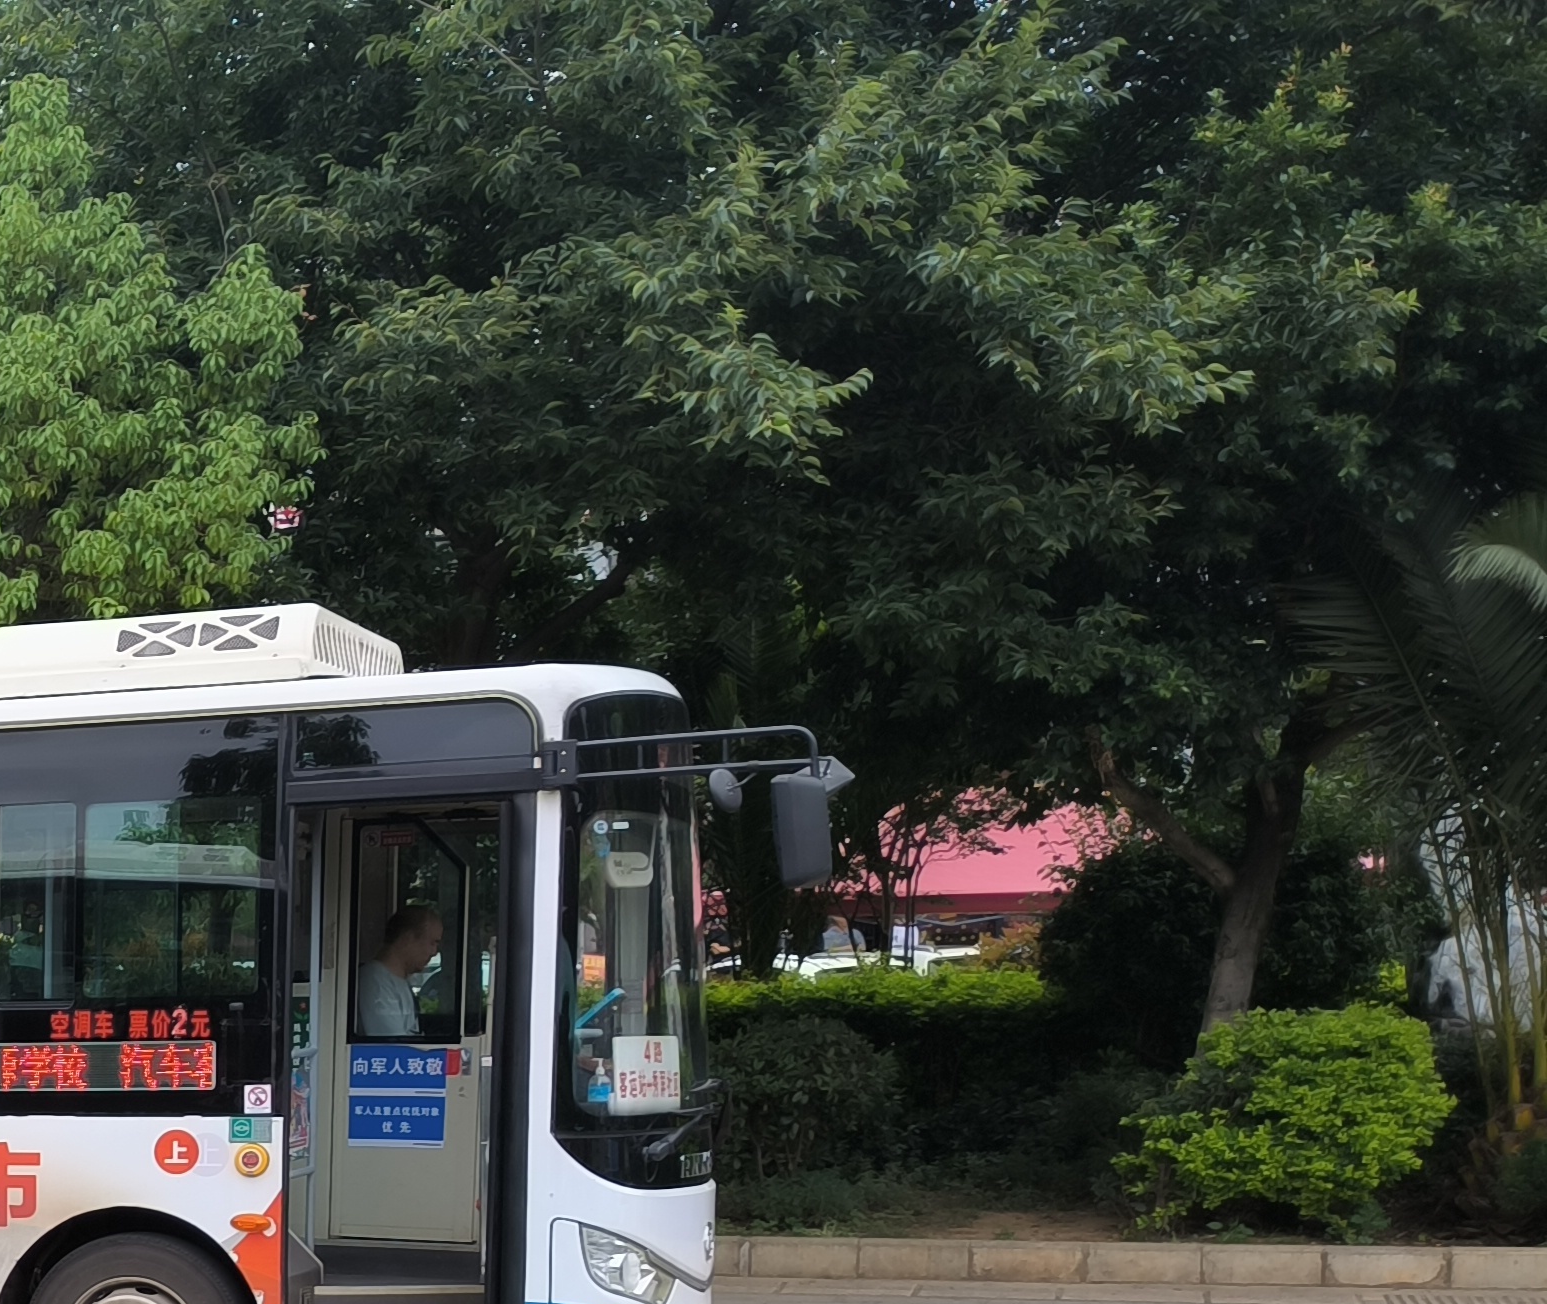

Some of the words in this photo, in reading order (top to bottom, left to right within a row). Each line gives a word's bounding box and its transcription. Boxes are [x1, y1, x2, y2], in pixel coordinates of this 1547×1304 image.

[50, 1010, 114, 1039] 空调车
[129, 1005, 211, 1039] 票价2元
[353, 1057, 444, 1076] 向军人致敬
[382, 1121, 412, 1133] 优先
[163, 1140, 190, 1164] 上
